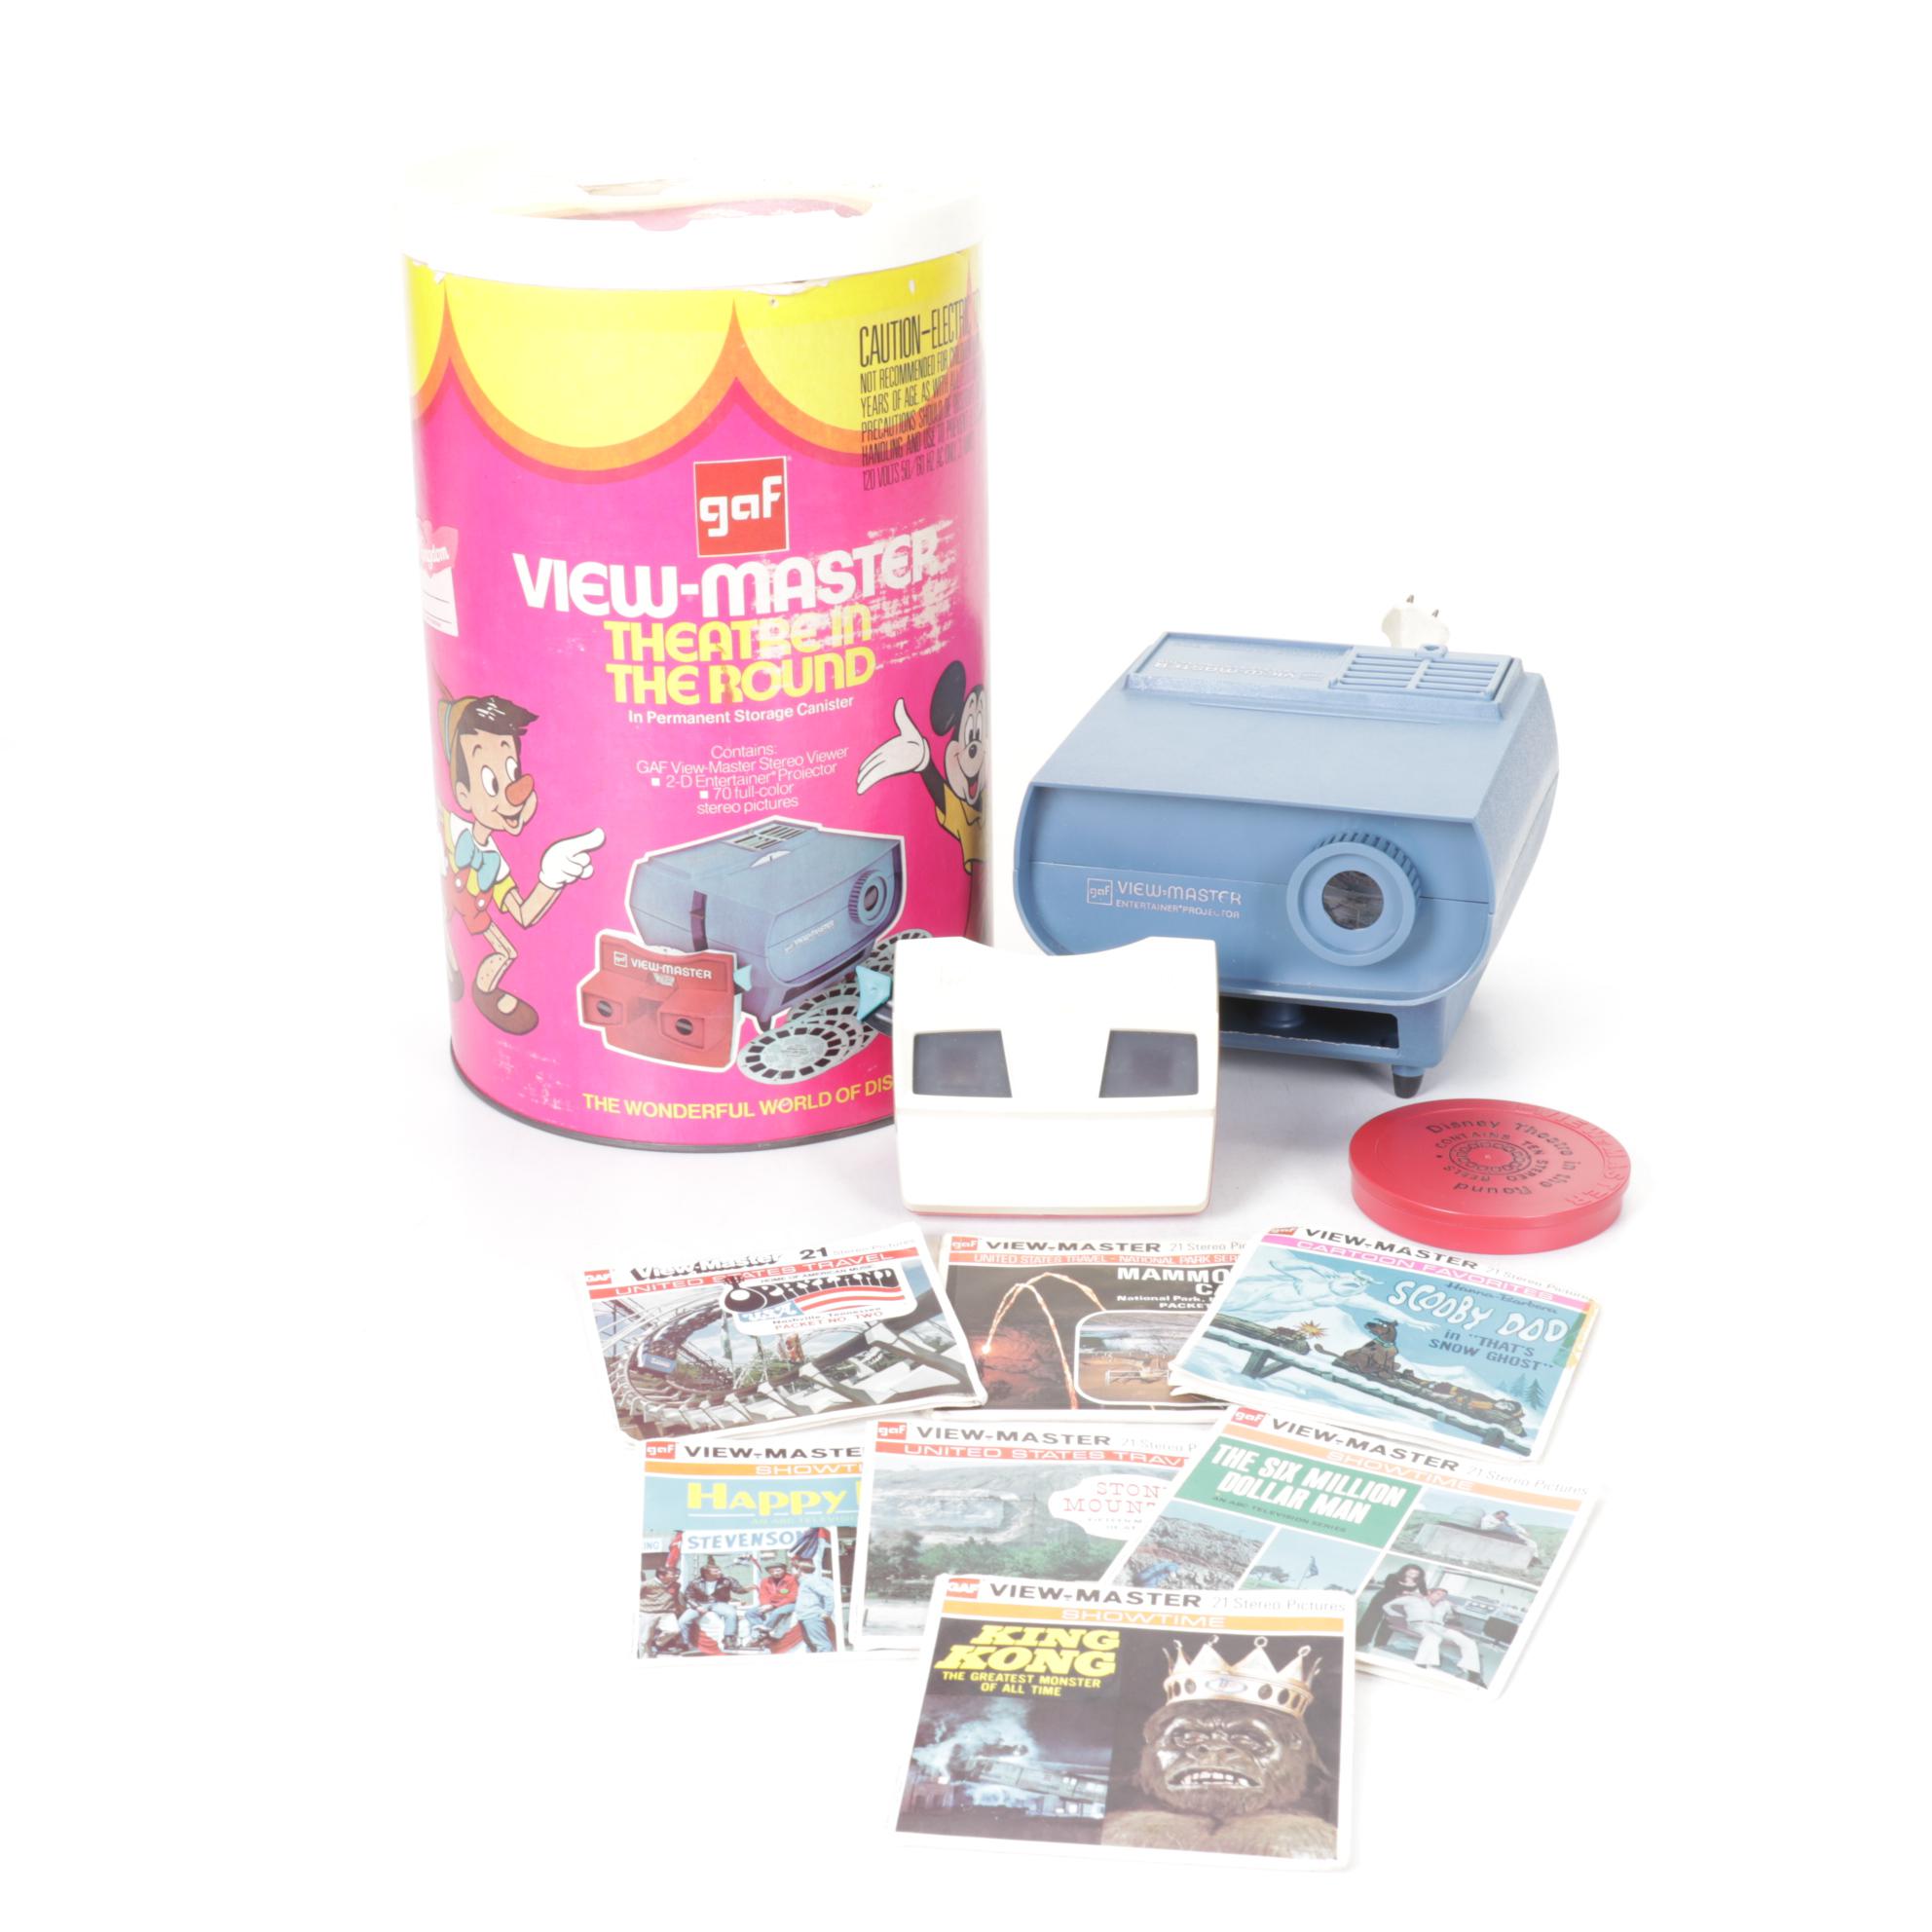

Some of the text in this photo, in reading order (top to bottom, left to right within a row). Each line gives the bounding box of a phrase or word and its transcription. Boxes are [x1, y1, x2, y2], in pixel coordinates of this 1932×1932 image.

[861, 370, 877, 394] NOT
[879, 353, 935, 390] RECOMMENDED
[861, 392, 889, 419] YEARS
[893, 390, 902, 411] OF
[921, 380, 930, 401] AS
[862, 410, 915, 442] PRECAUTIONS
[862, 436, 903, 467] HANDLING
[907, 431, 921, 455] AND
[923, 426, 936, 450] USE
[863, 468, 875, 492] 120
[877, 463, 900, 488] VOLTS
[699, 475, 782, 538] gaf
[512, 527, 940, 618] VIEW-MASTER
[604, 603, 873, 662] THEATRE IN
[606, 647, 877, 706] THE ROUND
[628, 696, 854, 724] In Permanent Storage Canister
[636, 747, 849, 775] GAF View-Master Stereo Viewer
[711, 745, 778, 760] Contains:
[666, 775, 693, 789] 2-D
[779, 762, 837, 782] Projector
[713, 782, 795, 800] 70 full-color
[697, 797, 799, 815] stereo pictures
[1090, 885, 1110, 898] gaf
[1117, 880, 1242, 906] VIEW-MASTER
[631, 957, 713, 980] VIEW-MASTER
[582, 1074, 894, 1120] THE WONDERFUL WORLD OF DIS
[1435, 1132, 1510, 1149] CONTAINS
[1521, 1140, 1544, 1156] TEN
[1426, 1121, 1581, 1195] Disney Theatre in the Round
[1506, 1160, 1549, 1182] STEREO
[799, 1246, 829, 1260] 21
[974, 1253, 1018, 1265] UNITED
[1020, 1253, 1062, 1265] STATES
[1065, 1253, 1107, 1264] TRAVEL
[1119, 1254, 1173, 1265] NATIONAL
[1179, 1254, 1211, 1264] PARK
[985, 1241, 1161, 1253] VIEW-MASTER
[1170, 1243, 1182, 1252] 21
[1305, 1228, 1479, 1271] VIEW-MASTER
[614, 1253, 895, 1296] UNITED STATES TRAVEL
[1295, 1240, 1554, 1303] CARTOON FAVORITES
[1387, 1281, 1570, 1343] SCOOBY DOO
[1429, 1338, 1480, 1357] SNOW
[1444, 1328, 1461, 1341] in
[878, 1425, 908, 1436] gaf
[916, 1426, 1111, 1446] VIEW-MASTER
[1235, 1412, 1264, 1424] gaf
[1272, 1418, 1460, 1472] VIEW-MASTER
[1467, 1466, 1483, 1477] 21
[647, 1445, 865, 1459] gaf VIEW-MASTE
[904, 1444, 1002, 1458] UNITED
[1011, 1446, 1105, 1461] STATES
[1210, 1444, 1407, 1507] THE SIX MILLION
[1324, 1450, 1475, 1492] SHOWTIME
[687, 1482, 846, 1516] Happy
[1096, 1481, 1167, 1500] STON
[1216, 1472, 1371, 1526] DOLLAR MAN
[989, 1582, 1202, 1607] VIEW-MASTER
[1212, 1597, 1229, 1609] 21
[1233, 1597, 1283, 1611] Stereo
[1286, 1598, 1346, 1613] Pictures
[1061, 1609, 1226, 1627] SHOWTIME
[970, 1625, 1120, 1651] KING
[935, 1646, 1117, 1677] KONG
[942, 1671, 1100, 1689] THE GREATEST MONSTER
[981, 1682, 1060, 1696] OF ALL TIME
